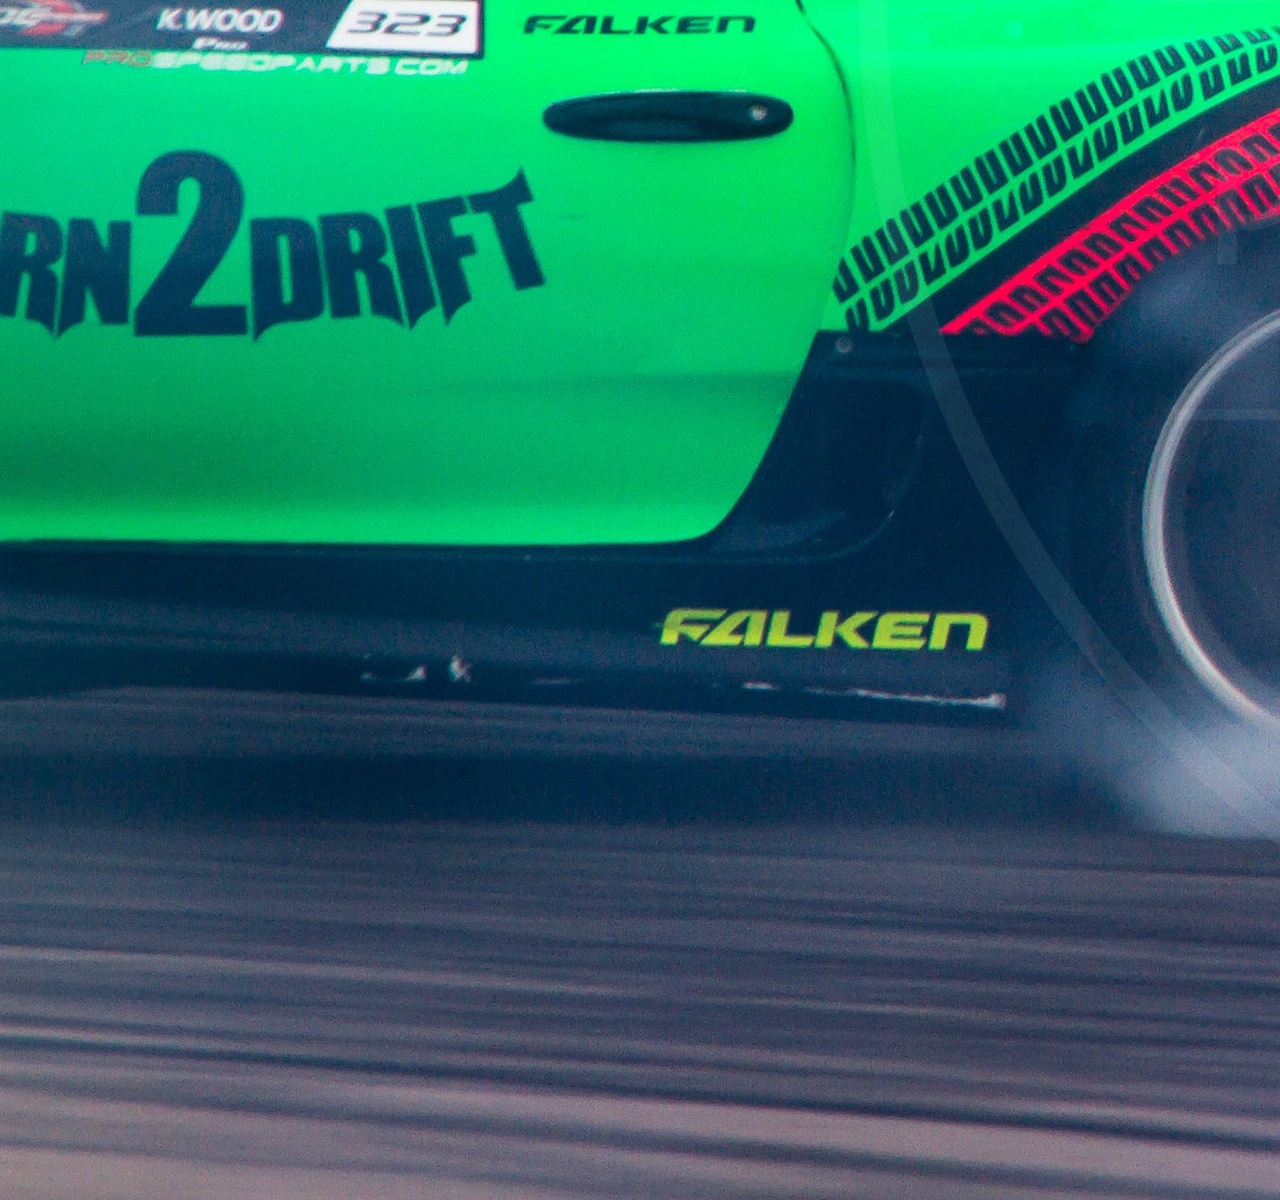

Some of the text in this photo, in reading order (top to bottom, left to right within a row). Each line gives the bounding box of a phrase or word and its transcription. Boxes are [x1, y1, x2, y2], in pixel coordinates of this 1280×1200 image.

[347, 10, 468, 37] 323
[523, 13, 756, 35] FALKEN
[659, 607, 990, 651] FALKEN
